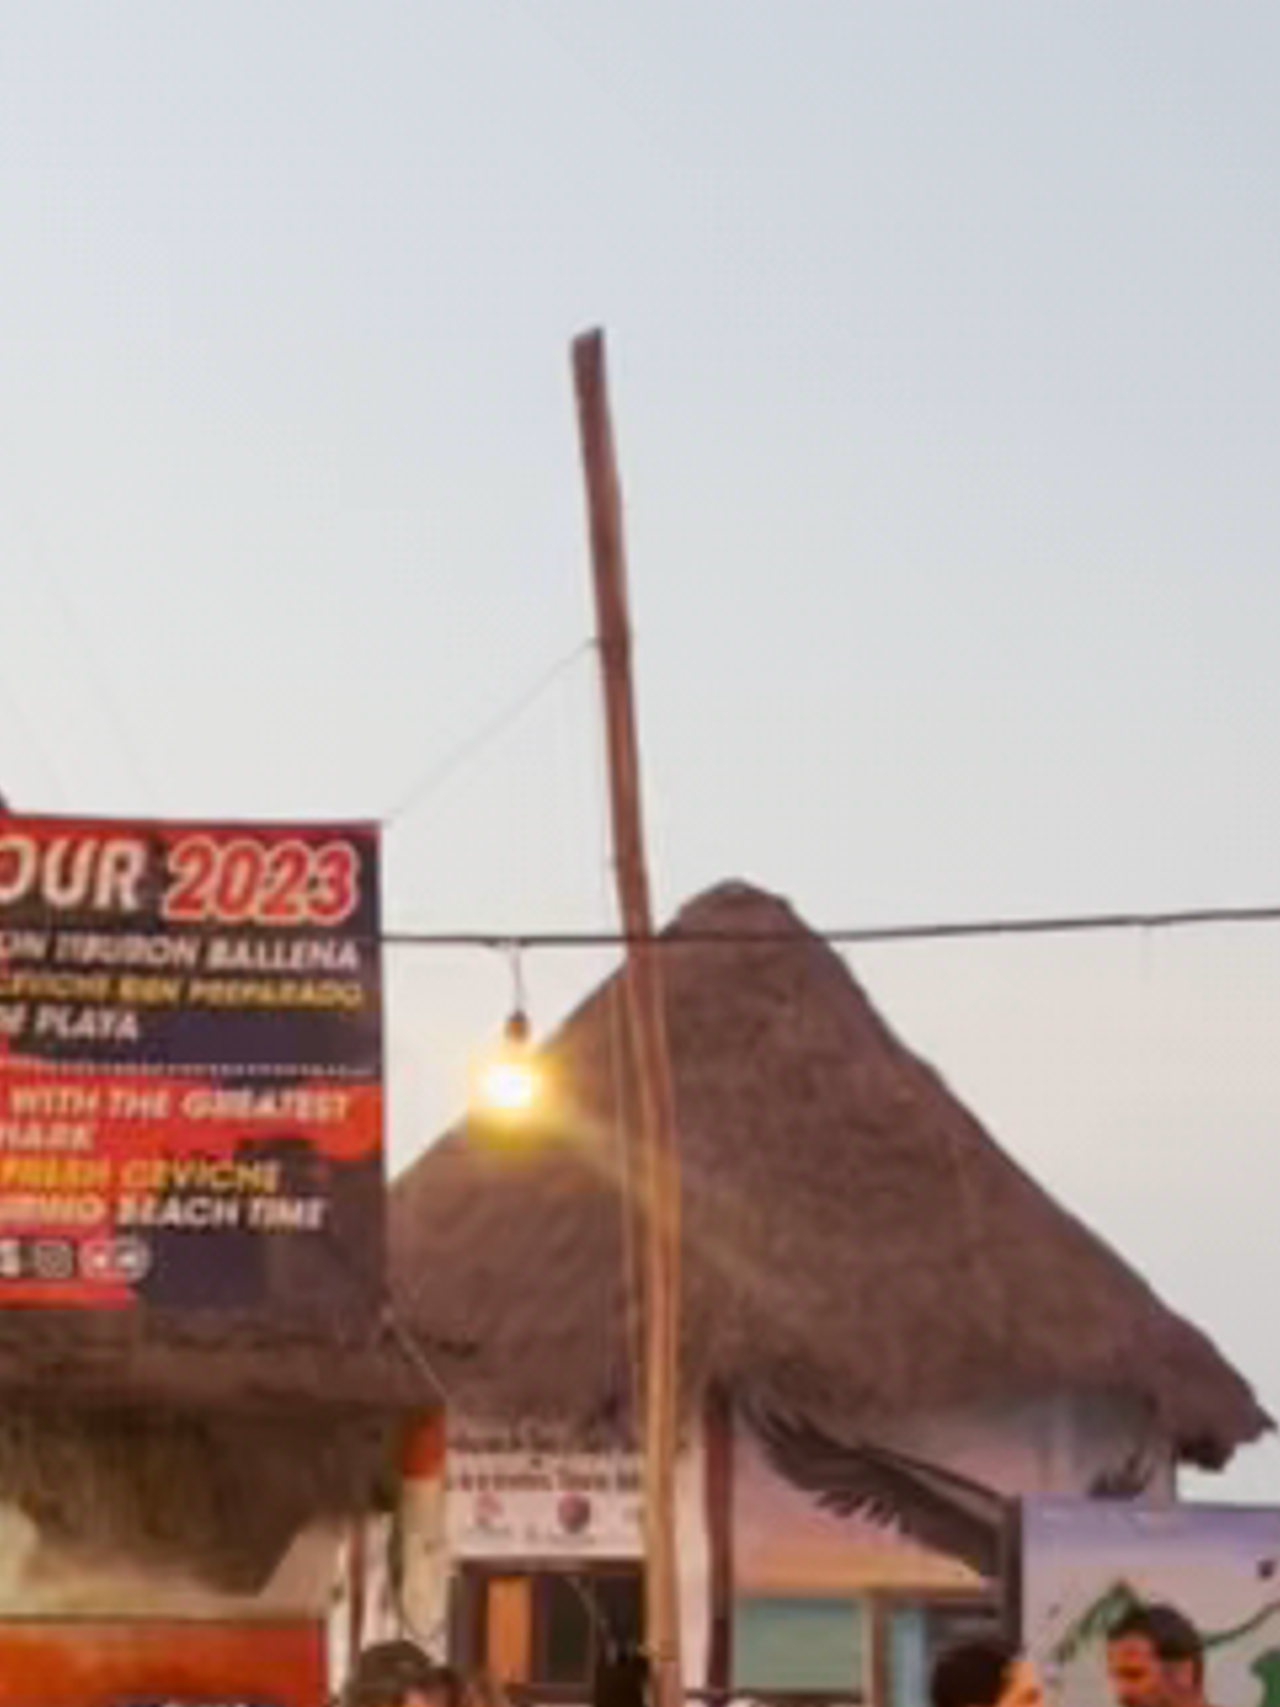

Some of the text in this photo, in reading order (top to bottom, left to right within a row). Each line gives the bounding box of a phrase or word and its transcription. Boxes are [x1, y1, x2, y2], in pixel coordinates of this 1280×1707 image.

[161, 837, 360, 925] 2023
[206, 936, 360, 971] BALLENA
[188, 980, 362, 1008] PREPARADO
[34, 1004, 139, 1041] PLAYA
[9, 1085, 101, 1117] WITH
[109, 1089, 168, 1119] THE
[180, 1089, 350, 1122] GREATEST
[1, 1159, 111, 1188] FRESH
[120, 1160, 280, 1194] CEVICHE
[117, 1195, 240, 1227] BEACH
[246, 1199, 328, 1230] TIME
